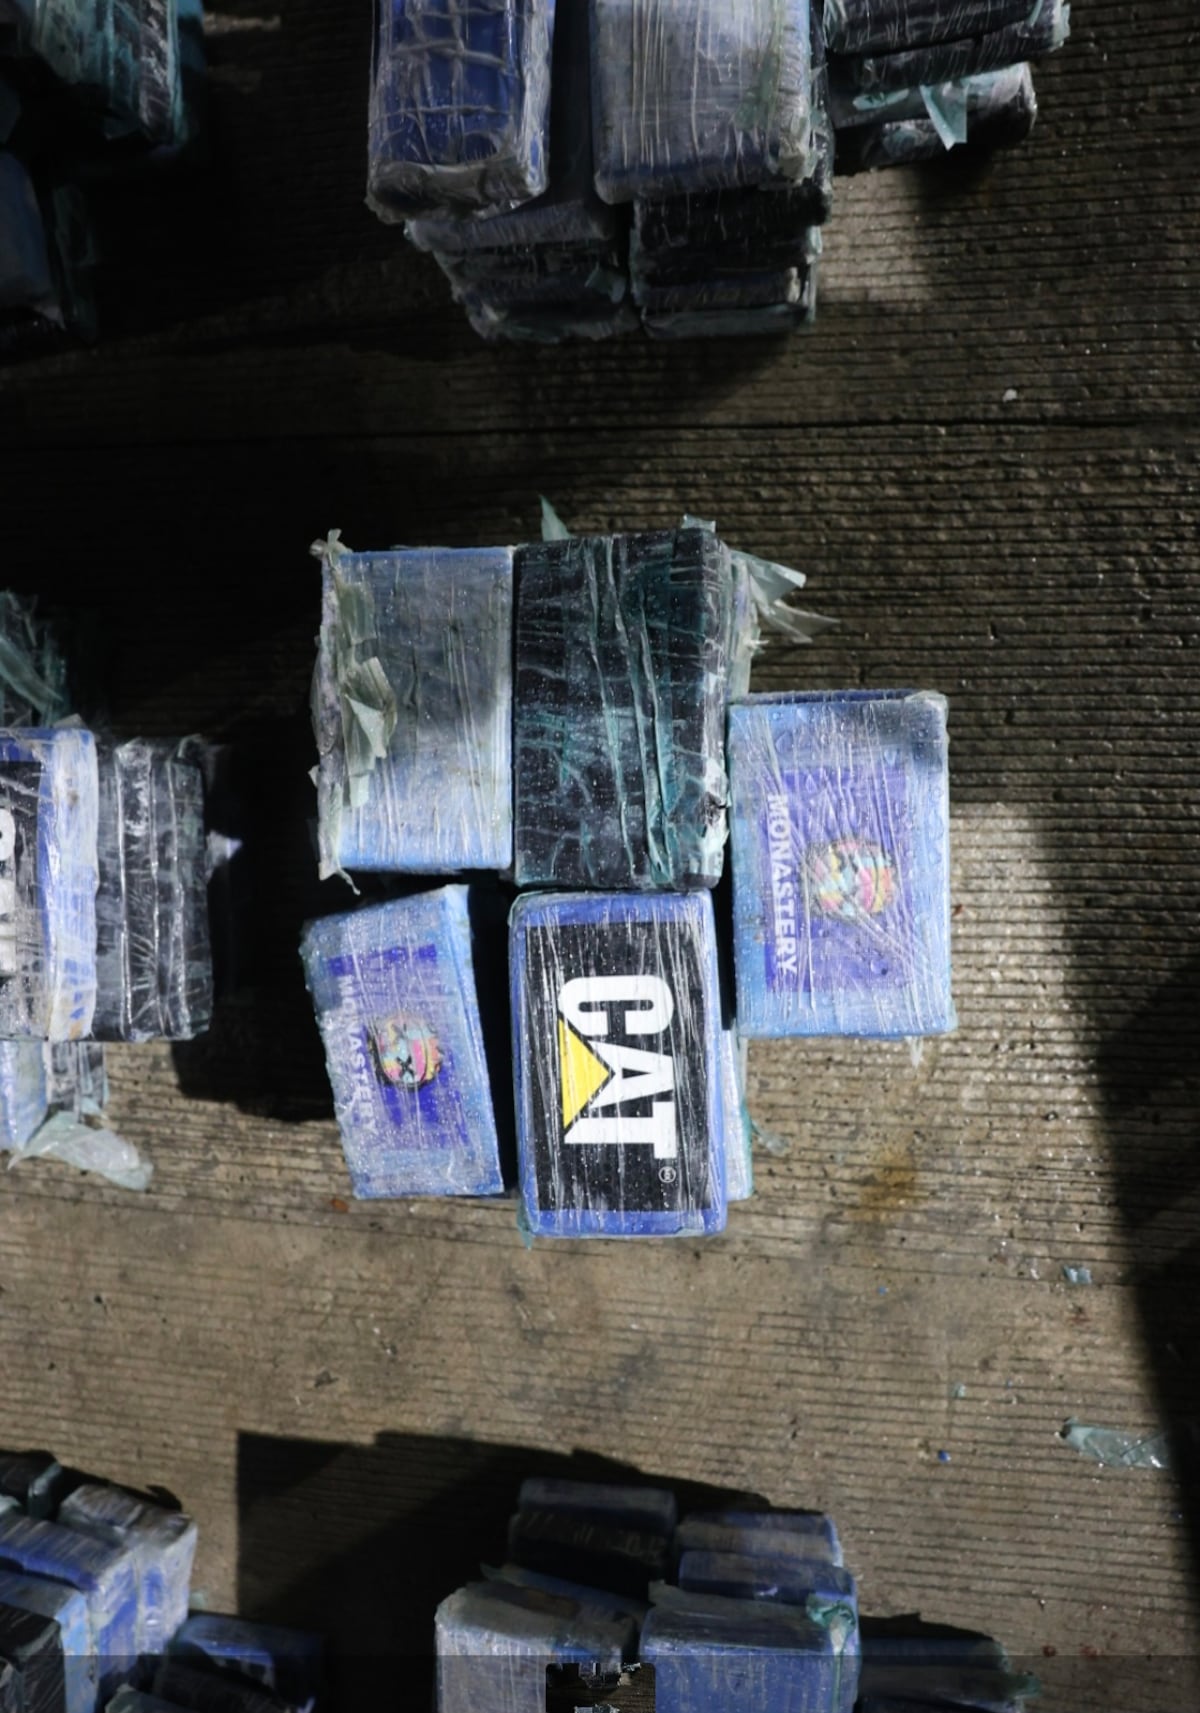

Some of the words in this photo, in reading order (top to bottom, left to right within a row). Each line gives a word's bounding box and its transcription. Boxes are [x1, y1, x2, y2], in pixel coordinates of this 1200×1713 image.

[767, 793, 798, 976] MONASTERY
[337, 974, 377, 1137] MONASTERY
[558, 974, 678, 1160] CAT
